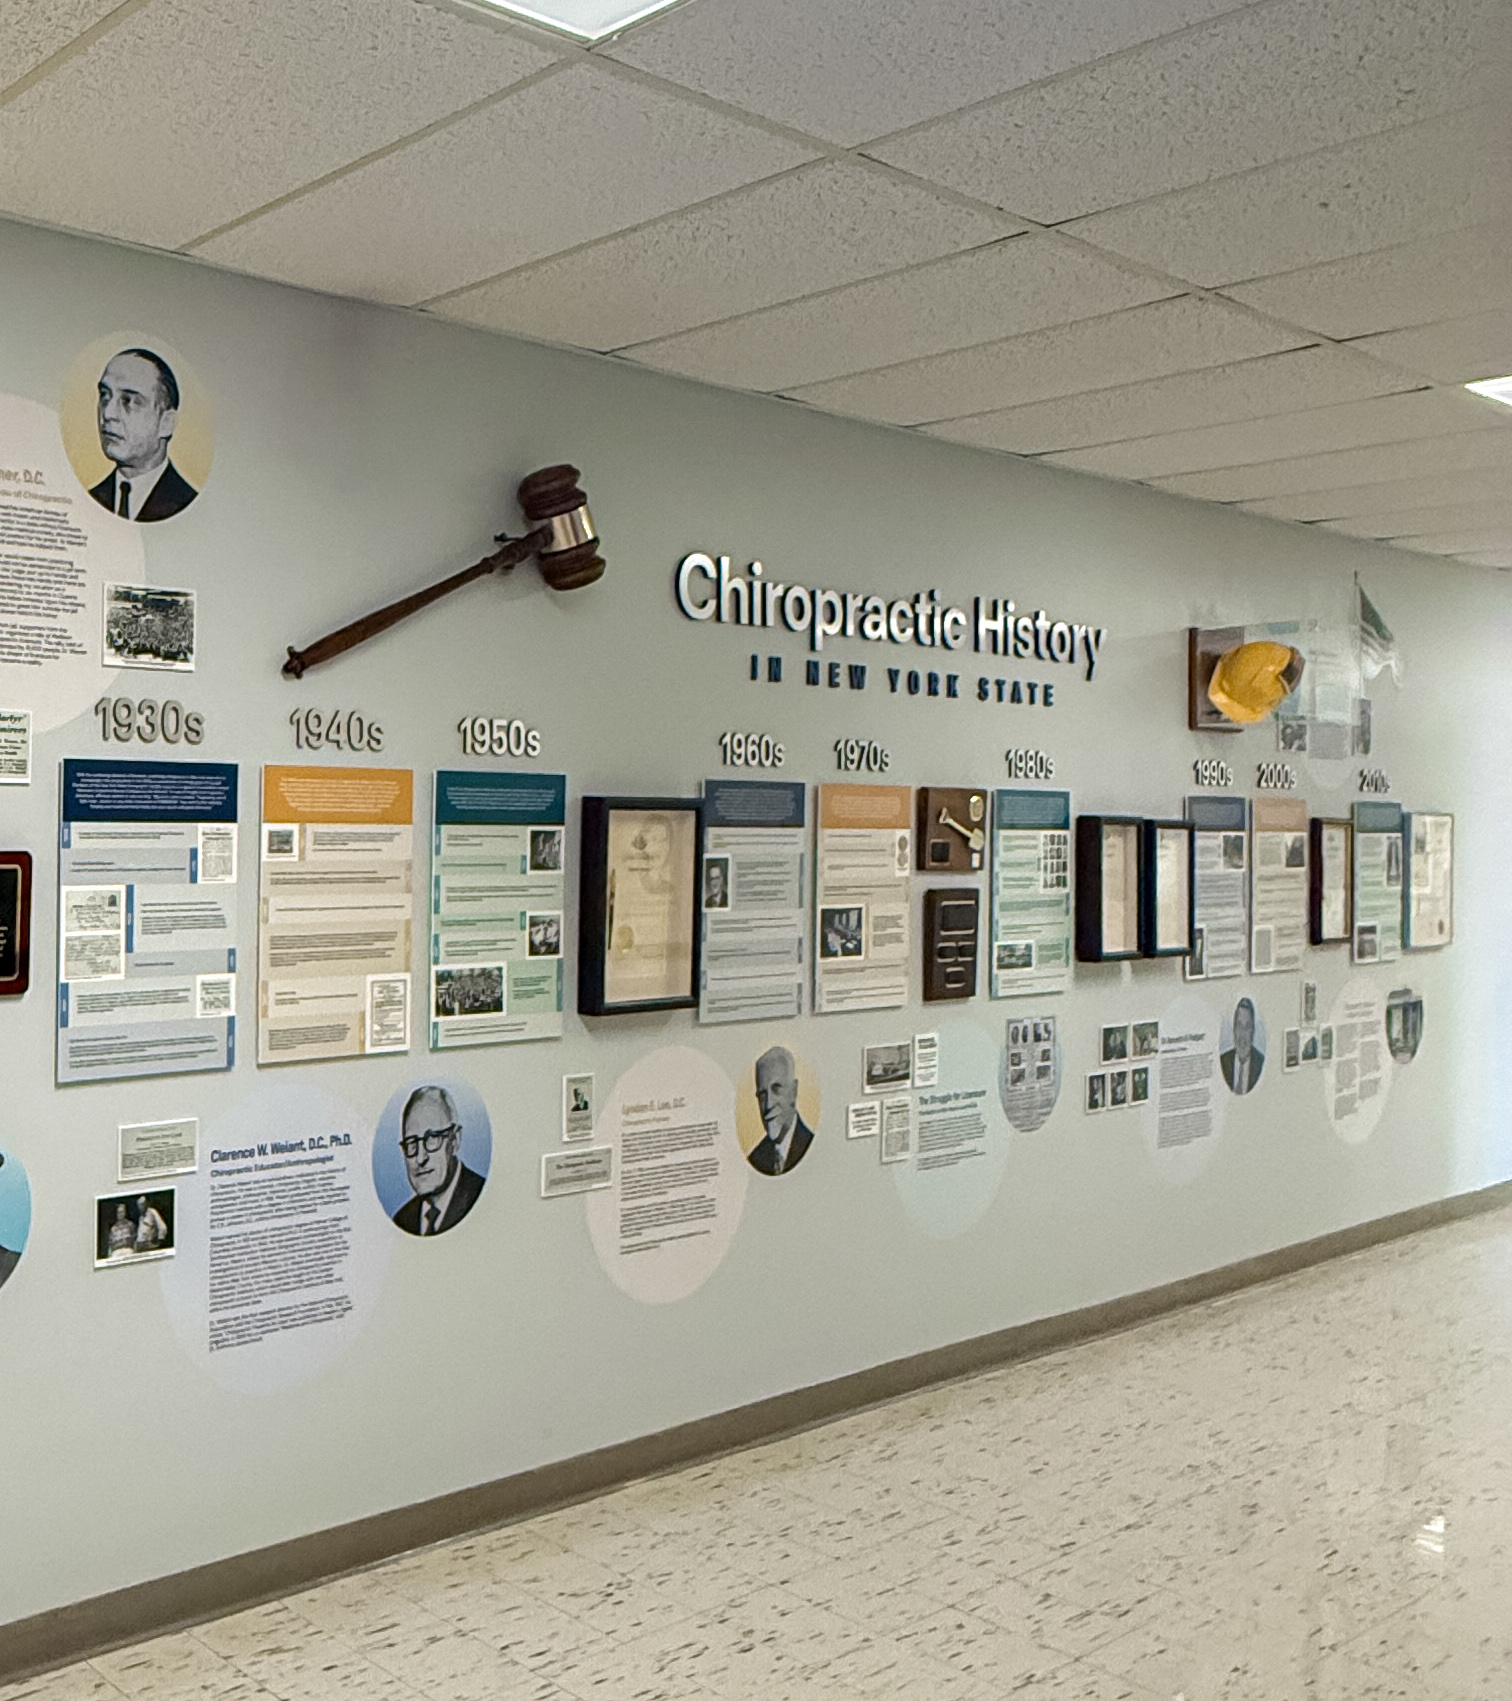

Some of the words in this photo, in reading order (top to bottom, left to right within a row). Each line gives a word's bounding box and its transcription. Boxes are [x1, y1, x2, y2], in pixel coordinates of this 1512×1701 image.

[676, 552, 967, 651] Chiropractic
[974, 597, 1107, 681] History
[750, 653, 782, 683] IN
[806, 659, 867, 690] NEW
[888, 667, 960, 698] YORK
[978, 676, 1055, 707] STATE
[95, 697, 204, 745] 1930s
[289, 707, 384, 752] 1940s
[458, 716, 540, 758] 1950s
[719, 732, 785, 767] 1960s
[834, 739, 891, 772] 1970s
[1005, 749, 1056, 779] 1980s
[1193, 759, 1234, 787] 1990s
[1257, 763, 1297, 789] 2000s
[211, 1148, 255, 1162] Clarence
[257, 1143, 268, 1157] W.
